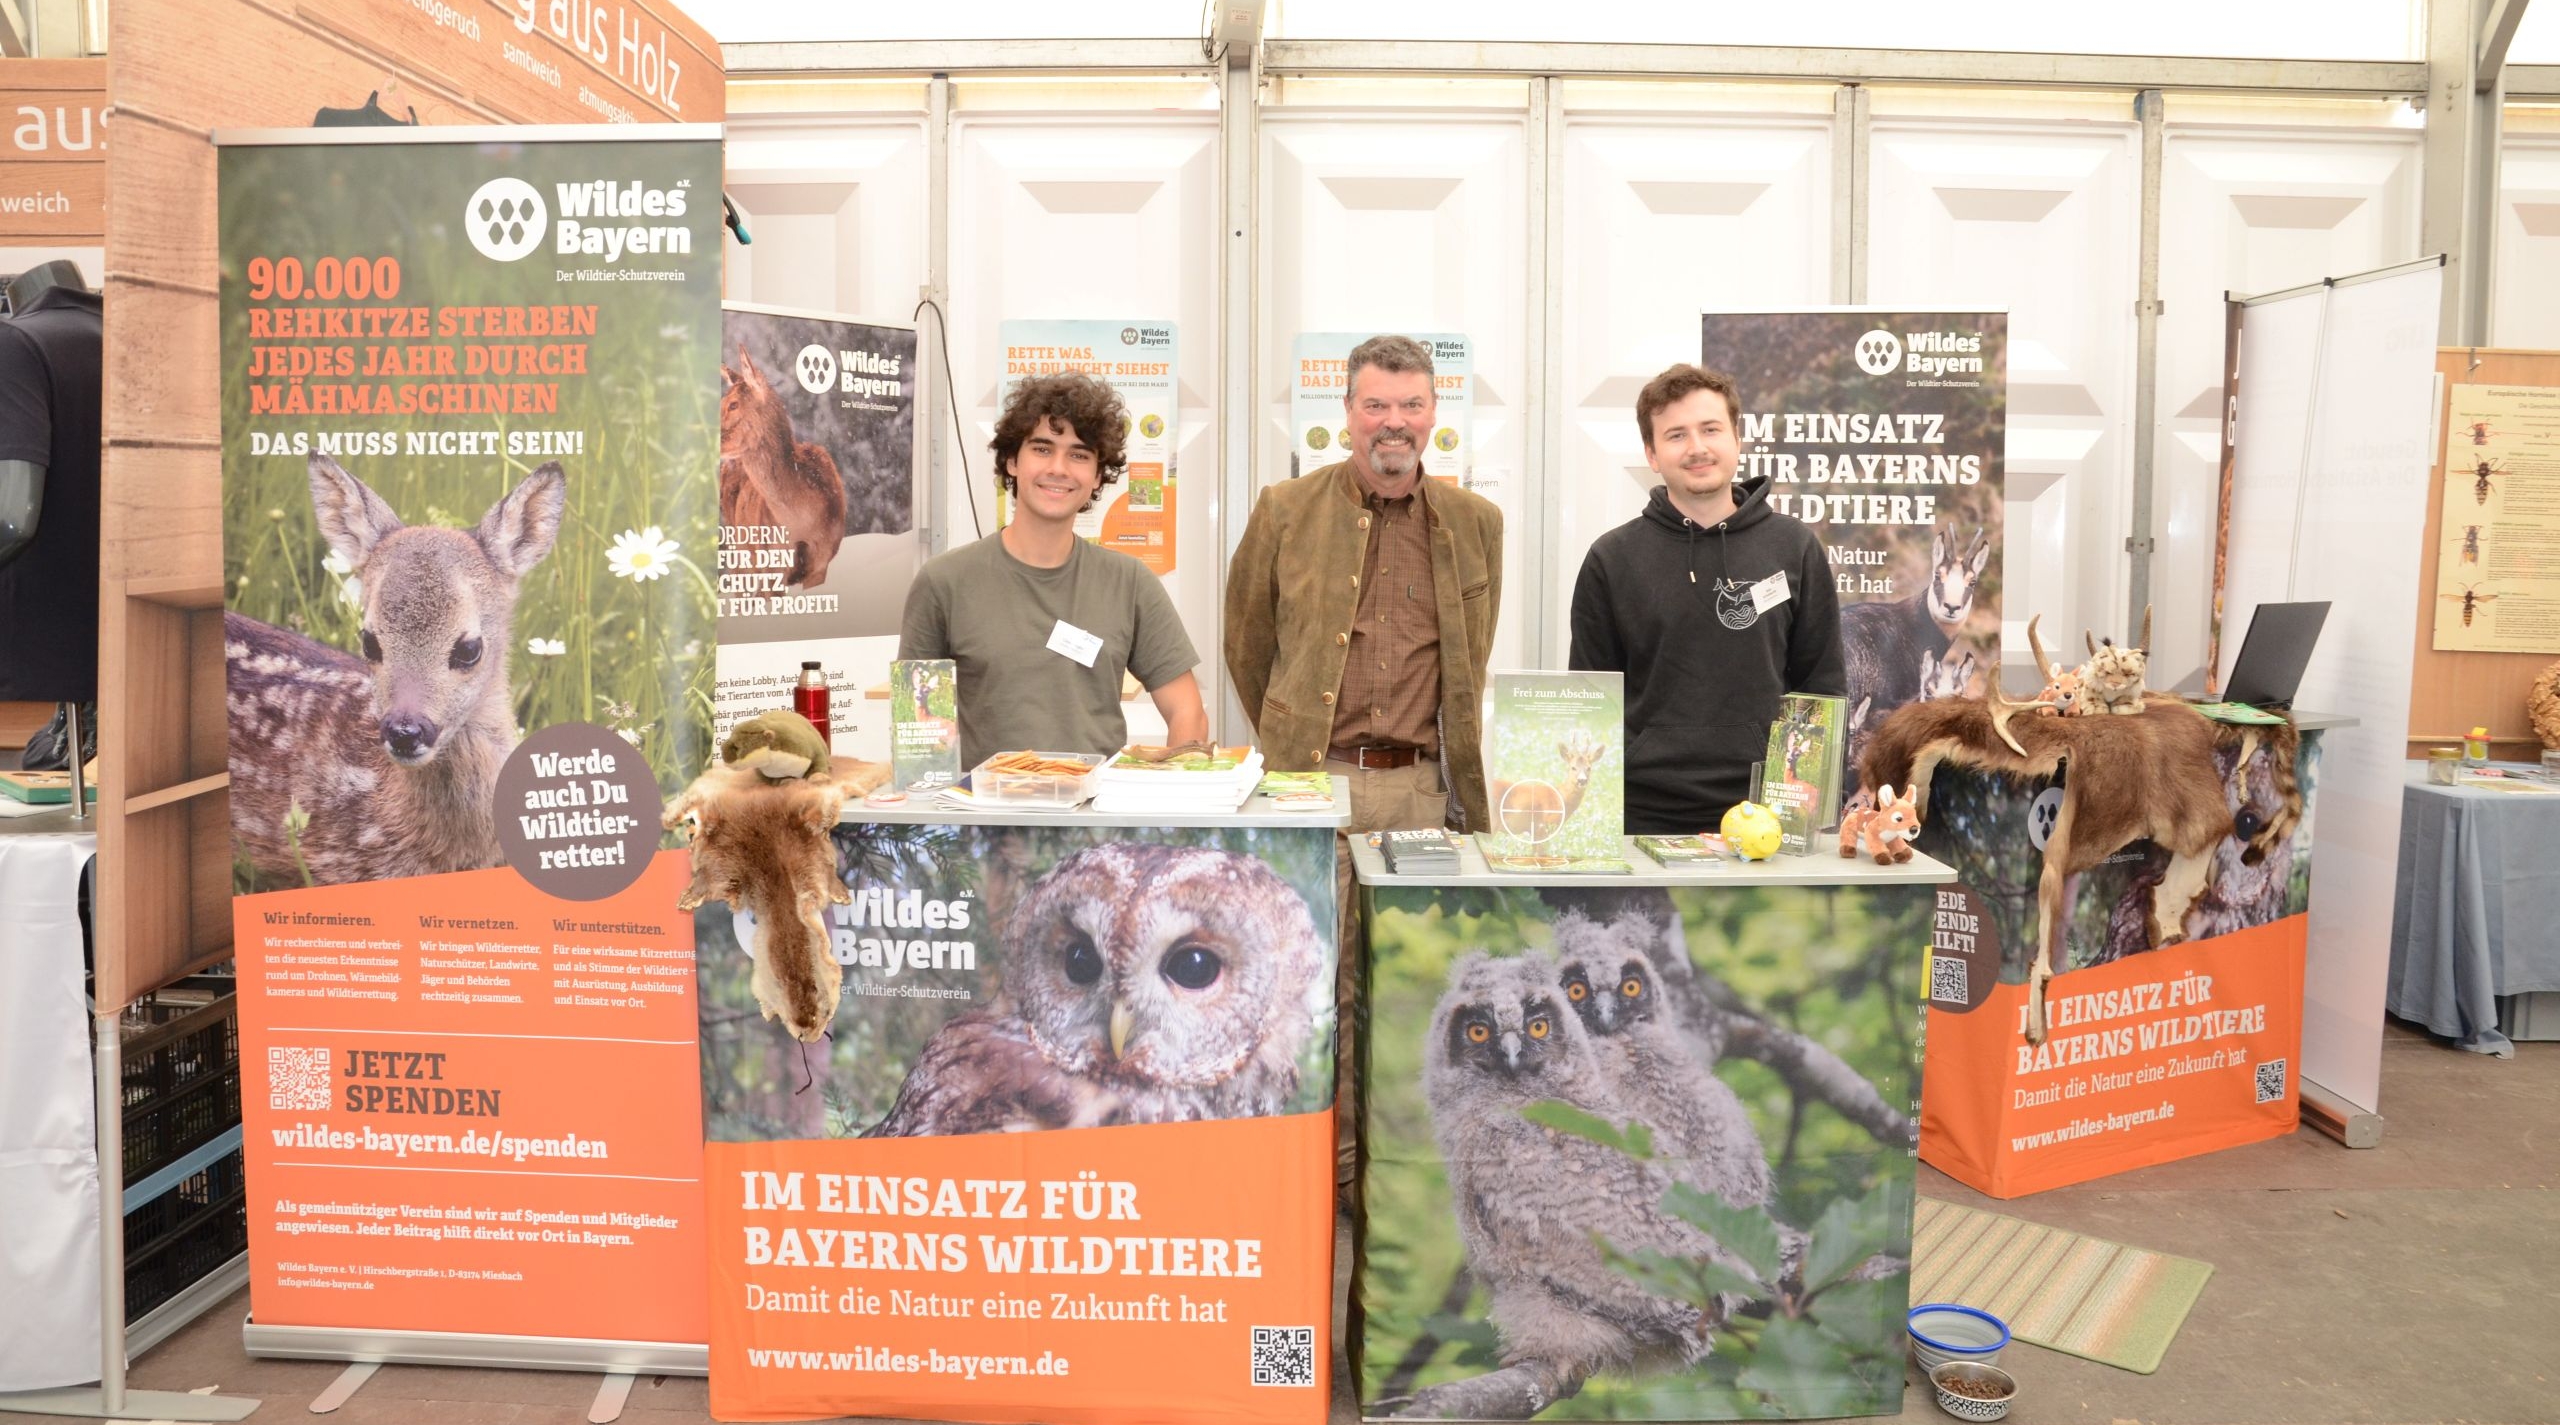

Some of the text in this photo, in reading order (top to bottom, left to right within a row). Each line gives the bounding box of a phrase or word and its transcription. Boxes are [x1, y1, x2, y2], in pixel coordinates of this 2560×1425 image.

[503, 42, 561, 89] samtweich
[550, 0, 680, 112] aus Holz
[0, 191, 70, 213] weich
[556, 179, 691, 217] Wildes e.V.
[557, 220, 691, 263] Bayern
[248, 257, 400, 300] 90.000
[556, 269, 685, 281] Der Wildtier-Schutzverein
[249, 305, 598, 338] REHKITZE STERBEN
[1140, 328, 1169, 337] Wildes
[1140, 337, 1170, 346] Bayern
[1436, 341, 1464, 349] Wildes
[1906, 331, 1980, 352] Wildes
[248, 344, 587, 377] JEDES JAHR DURCH
[840, 350, 900, 375] Wildes
[1007, 347, 1095, 360] RETTE WAS,
[1436, 350, 1464, 359] Bayern
[1907, 353, 1982, 377] Bayern
[1007, 362, 1169, 375] DAS DU NICHT SIEHST
[1301, 360, 1348, 372] RETTE
[841, 372, 901, 399] Bayern
[1301, 375, 1331, 387] DAS
[250, 377, 559, 415] MÄHMASCHINEN
[1784, 413, 1944, 444] EINSATZ
[250, 430, 584, 456] DAS MUSS NICHT SEIN!
[1731, 446, 1981, 486] FÜR BAYERNS
[1764, 494, 1936, 525] ILDTIERE
[717, 545, 795, 569] FÜR DEN
[1827, 546, 1887, 565] Natur
[717, 573, 789, 594] CHUTZ,
[1860, 575, 1893, 594] hat
[730, 593, 839, 616] FÜR PROFIT!
[730, 678, 751, 687] keine
[752, 676, 778, 686] Lobby.
[829, 670, 844, 679] sind
[727, 690, 765, 700] Tierarten
[1513, 687, 1605, 699] Frei zum Abschuss
[530, 748, 616, 778] Werde
[525, 780, 629, 809] auch Du
[519, 809, 638, 840] Wildtier-
[539, 840, 625, 869] retter!
[832, 887, 975, 930] Wildes e.V.
[1936, 891, 1967, 911] EDE
[264, 912, 375, 926] Wir informieren.
[419, 915, 519, 930] Wir vernetzen.
[553, 919, 666, 936] Wir unterstützen.
[1934, 911, 1979, 934] ENDE
[264, 937, 402, 950] Wir recherchieren und verbrei-
[420, 941, 437, 951] Wir
[439, 941, 474, 954] bringen
[553, 944, 696, 960] Für eine wirksame Kitzrettung
[831, 929, 975, 977] Bayern
[1934, 930, 1975, 954] ILFT!
[265, 954, 399, 966] ten die neuesten Erkenntnisse
[554, 962, 688, 976] und als Stimme der Wildtiere
[265, 970, 288, 980] rund
[290, 972, 305, 980] um
[421, 974, 510, 987] Jäger und Behörden
[554, 978, 569, 988] mit
[631, 981, 684, 994] Ausbildung
[266, 986, 399, 1002] kameras und Wildtierrettung.
[421, 991, 524, 1004] rechtzeitig zusammen.
[554, 995, 646, 1008] und Einsatz vor Ort.
[855, 984, 971, 1000] Wildtier-Schutzverein
[2058, 983, 2163, 1028] EINSATZ
[2167, 970, 2212, 1008] FÜR
[2016, 1005, 2265, 1075] BAYERNS WILDTIERE
[344, 1050, 446, 1081] JETZT
[2014, 1047, 2247, 1109] Damit die Natur eine Zukunft hat
[346, 1084, 500, 1118] SPENDEN
[2011, 1101, 2175, 1152] www.wildes-bayern.de
[272, 1123, 608, 1162] wildes-bayern.de/spenden
[741, 1171, 1140, 1221] IM EINSATZ FÜR
[275, 1200, 678, 1230] Als gemeinnütziger Verein sind wir auf Spenden und Mitglieder
[275, 1220, 634, 1248] angewiesen. Jeder Beitrag hilft direkt vor Ort in Bayern.
[744, 1226, 1262, 1279] BAYERNS WILDTIERE
[278, 1262, 306, 1272] Wildes
[308, 1263, 338, 1274] Bayern
[364, 1265, 439, 1279] Hirschbergstraße
[482, 1270, 523, 1281] Miesbach
[278, 1277, 374, 1290] info@wildes-bayern.de
[745, 1283, 1227, 1323] Damit die Natur eine Zukunft hat
[748, 1347, 1070, 1380] www.wildes-bayern.de
